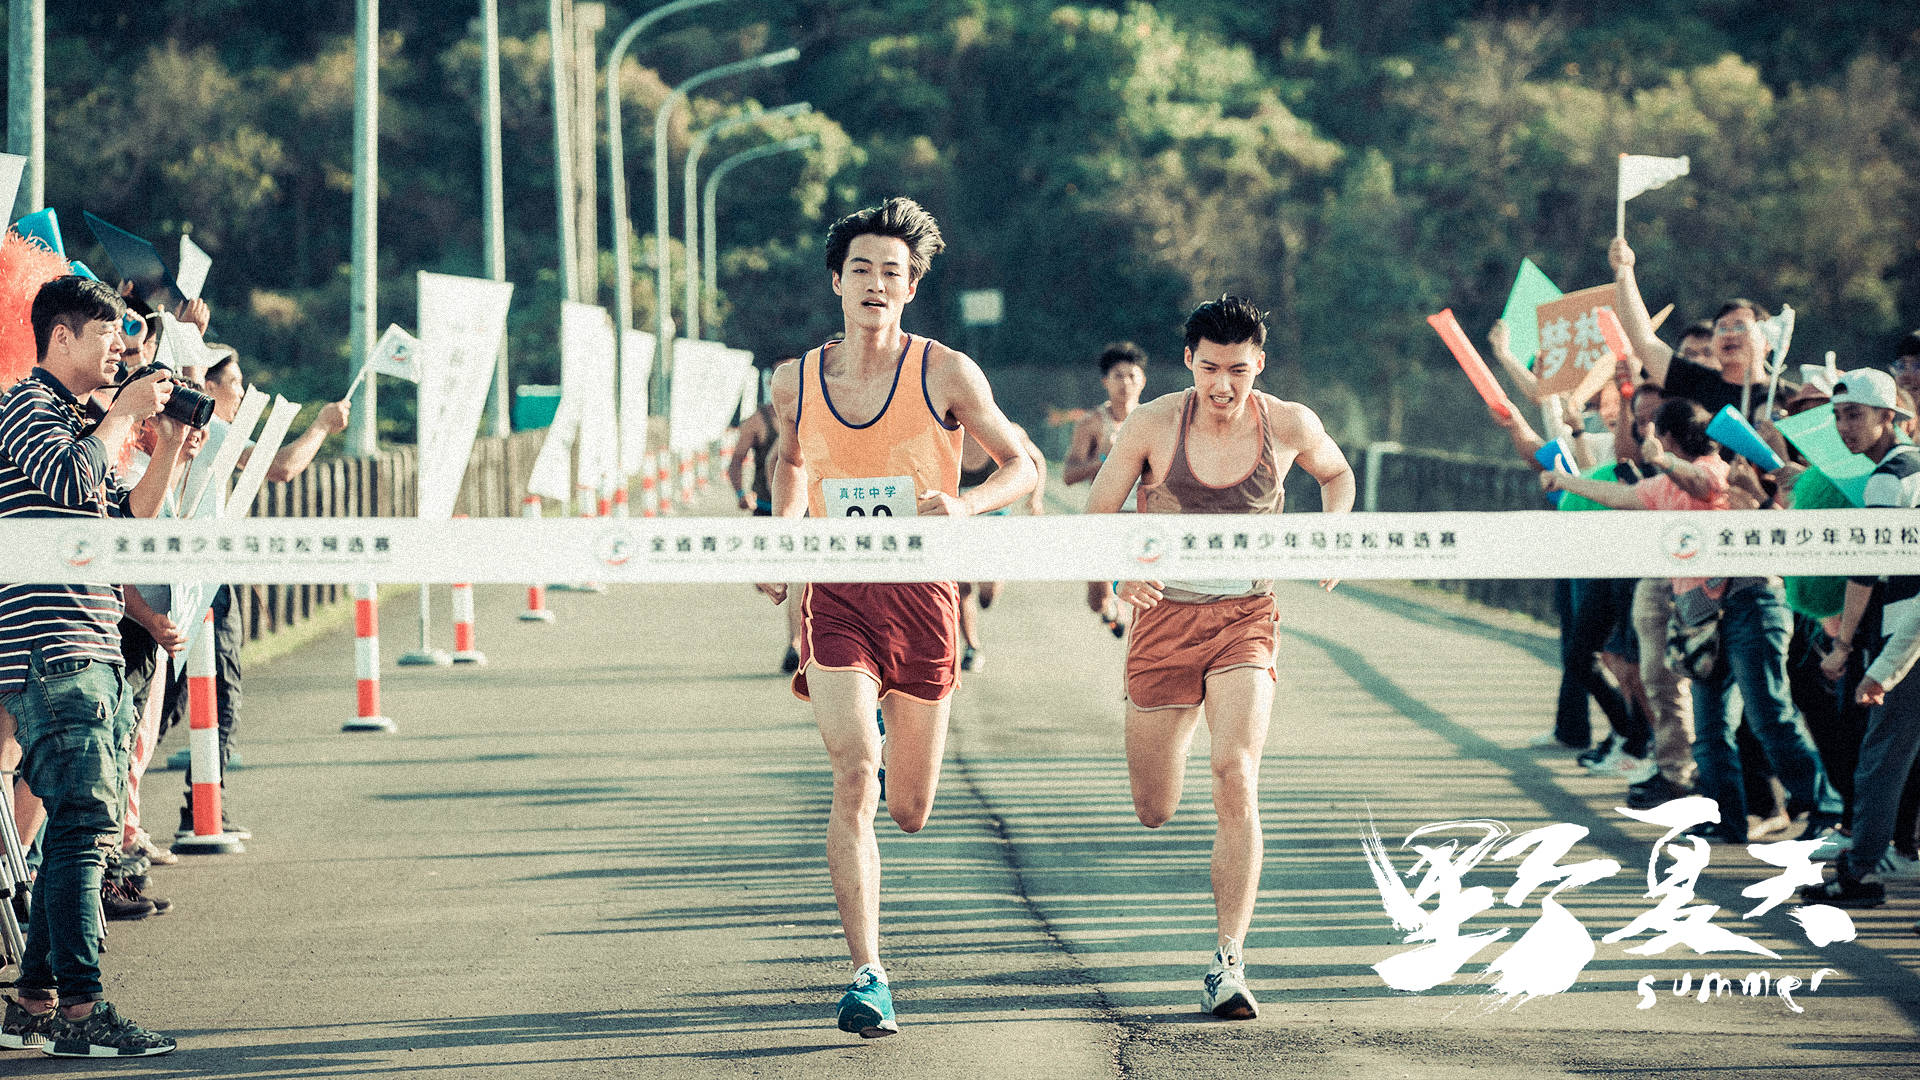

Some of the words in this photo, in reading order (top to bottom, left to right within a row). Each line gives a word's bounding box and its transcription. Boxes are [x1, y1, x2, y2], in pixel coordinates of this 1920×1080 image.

[839, 486, 897, 499] 真花中学
[114, 535, 391, 553] 全省青少年马拉松预选赛
[651, 534, 923, 552] 全省青少年马拉松预选赛
[1182, 531, 1457, 549] 全省青少年马拉松预选赛
